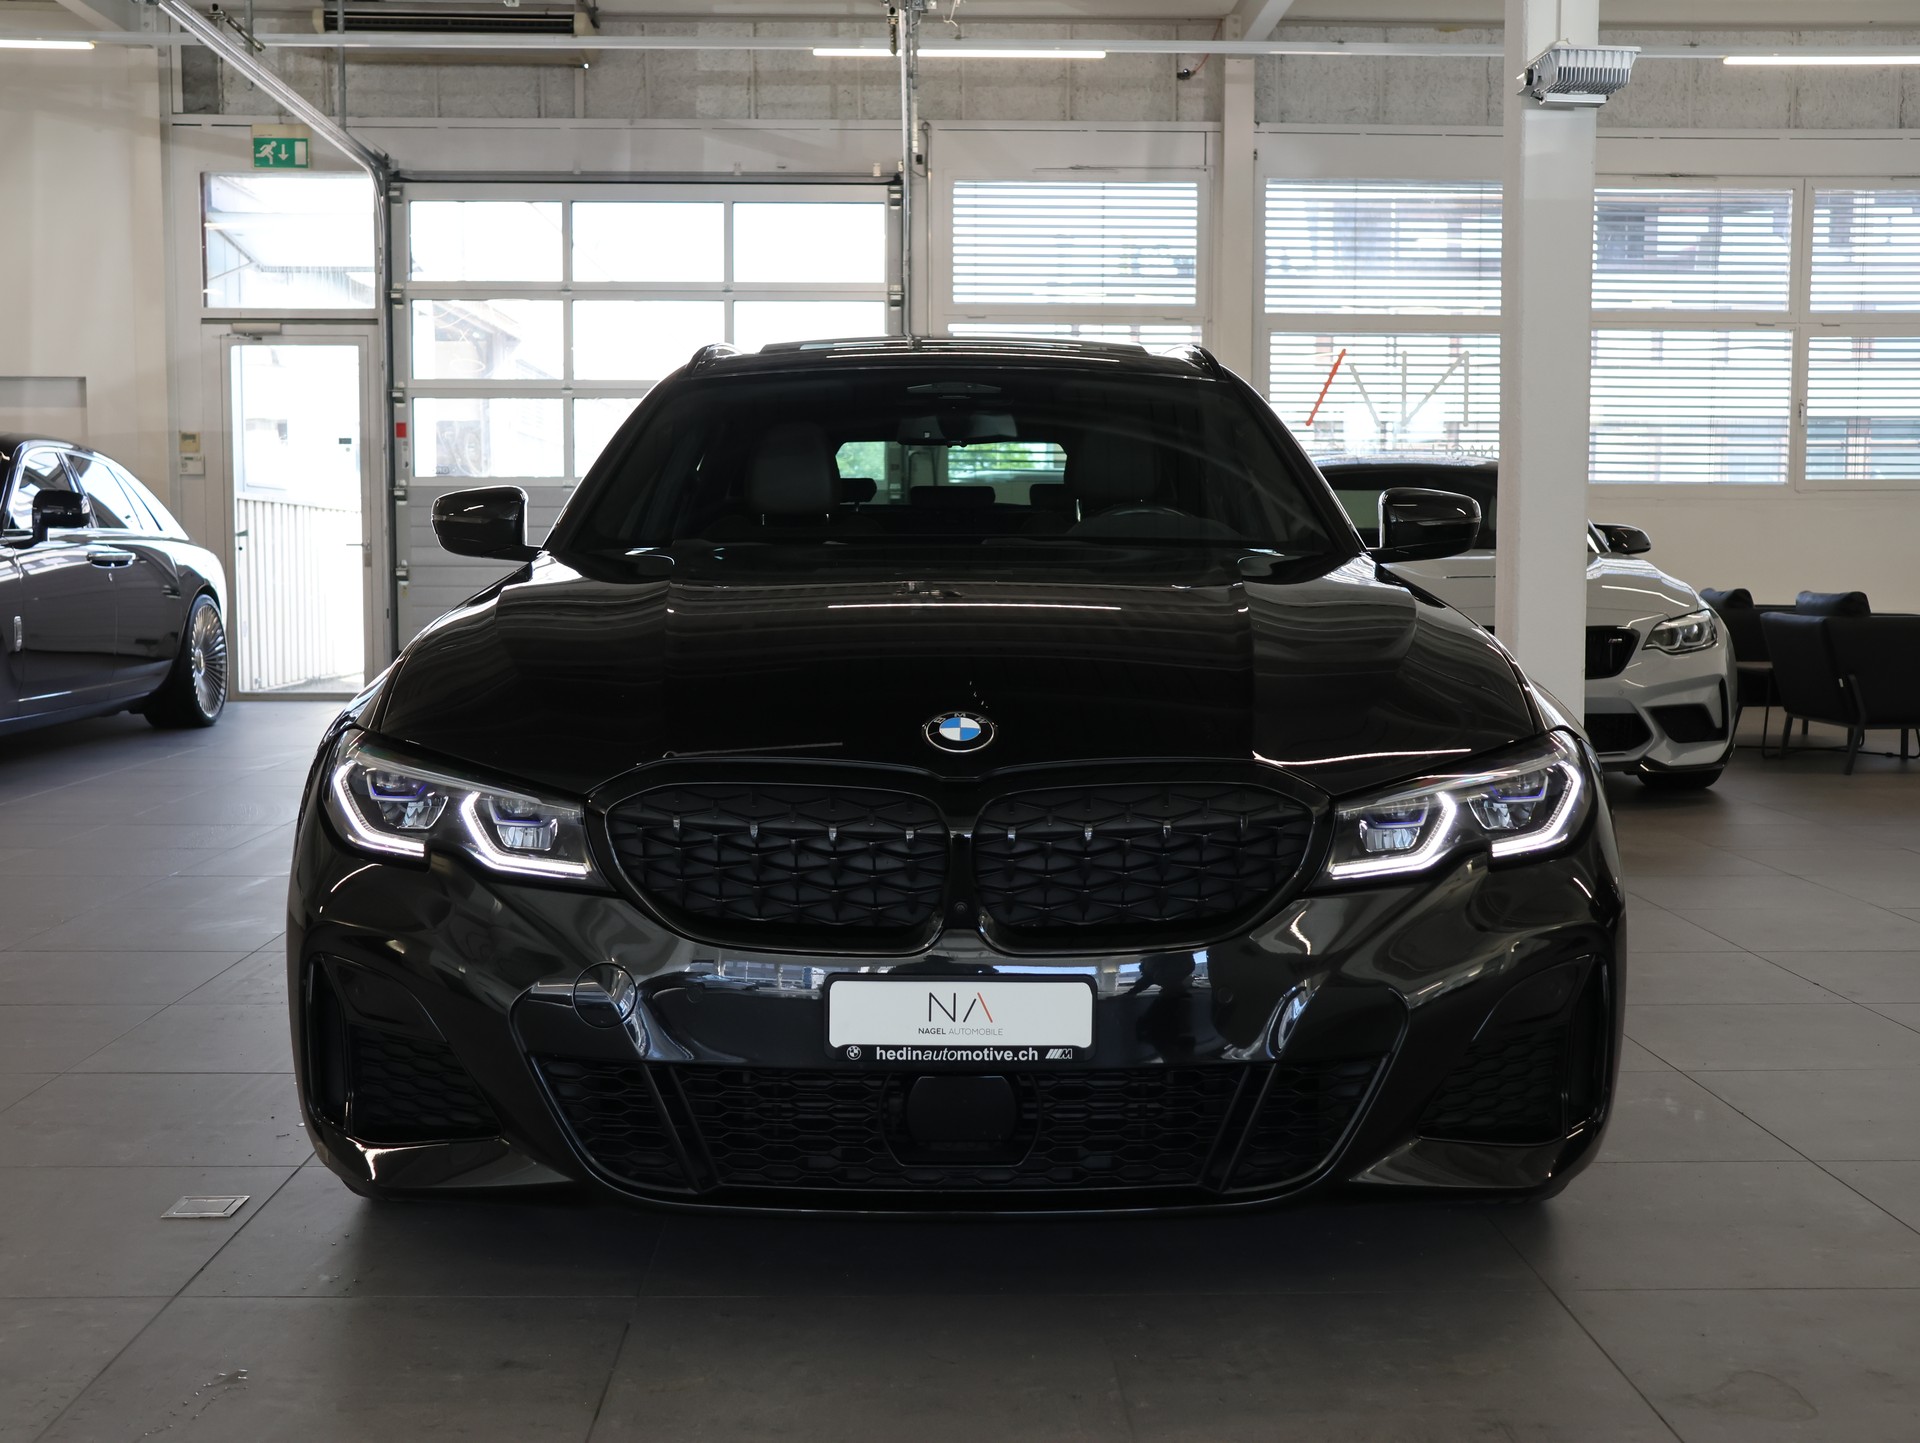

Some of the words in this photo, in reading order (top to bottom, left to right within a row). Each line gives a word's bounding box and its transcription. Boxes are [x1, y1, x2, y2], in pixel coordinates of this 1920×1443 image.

[918, 1027, 946, 1035] NAGEL
[948, 1028, 1004, 1036] AUTOMOBILE
[876, 1047, 1038, 1061] hedinautomotive.ch
